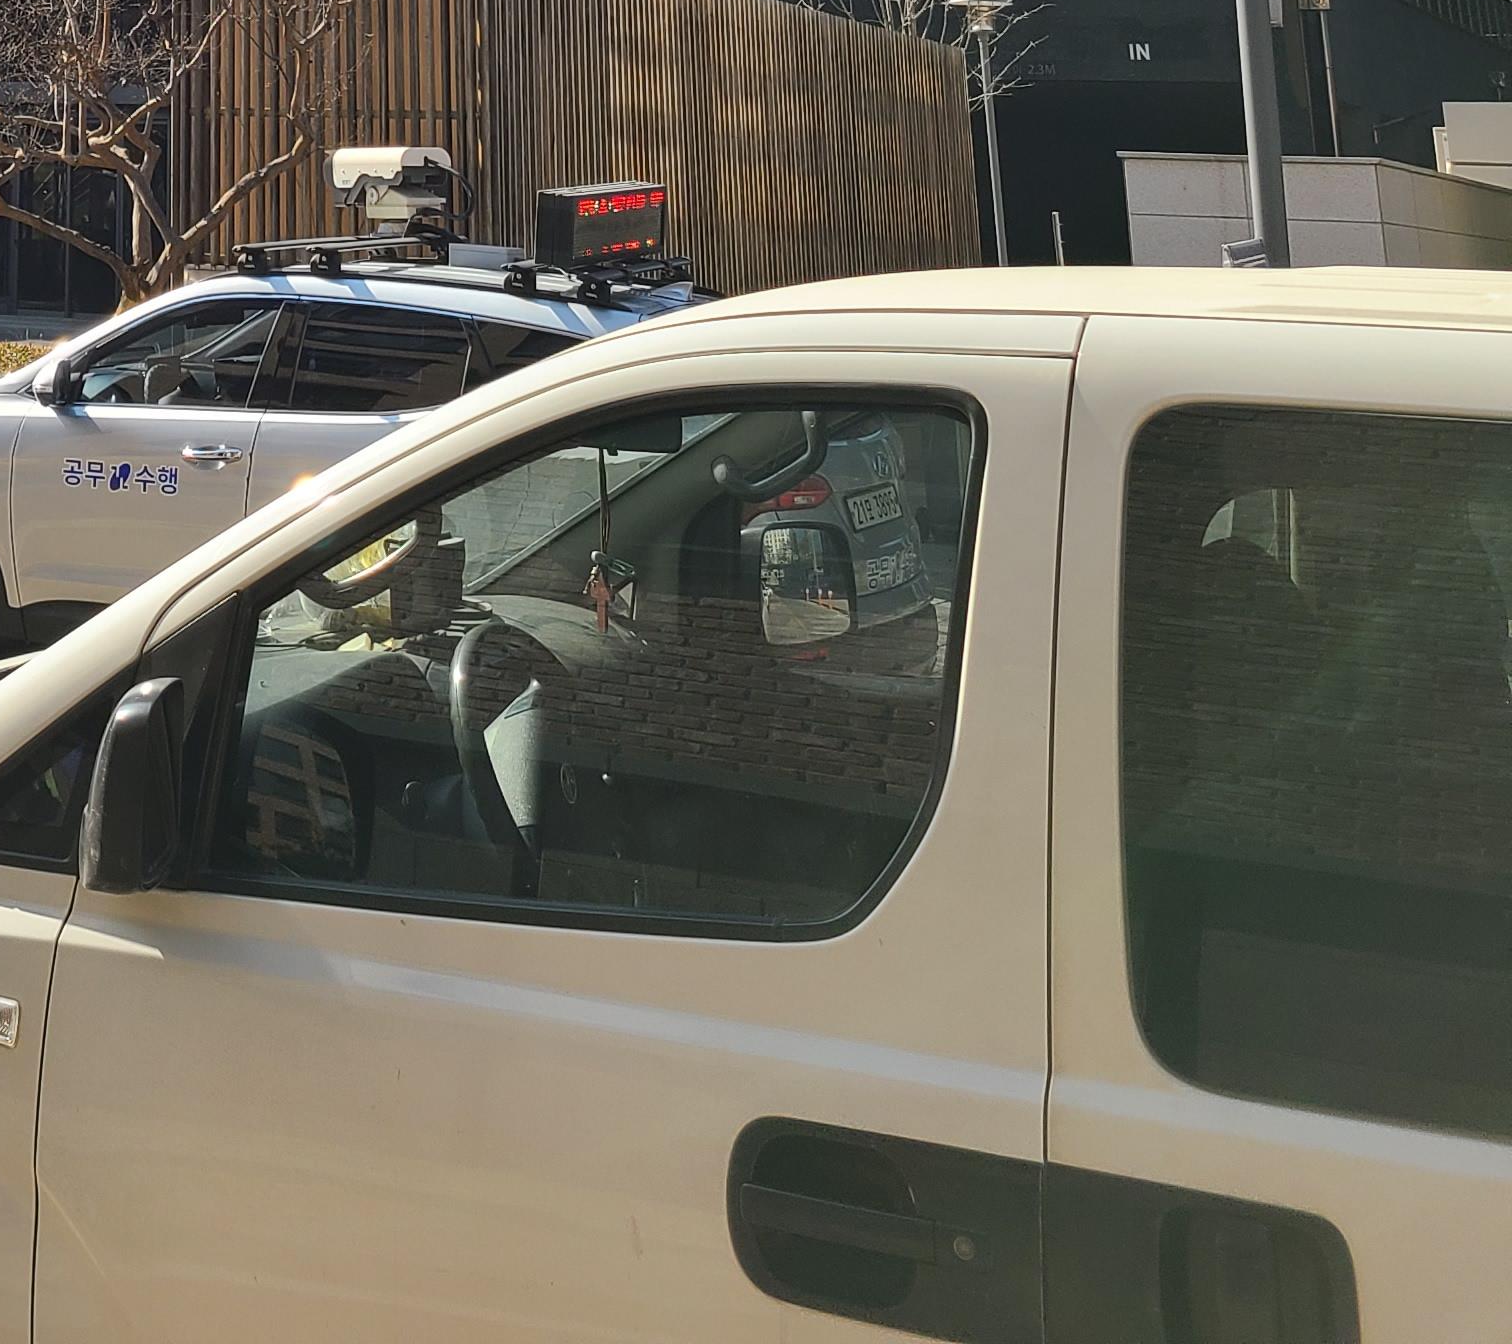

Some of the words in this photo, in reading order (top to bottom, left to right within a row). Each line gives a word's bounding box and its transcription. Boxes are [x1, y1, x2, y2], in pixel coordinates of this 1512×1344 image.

[1128, 43, 1152, 61] IN
[62, 458, 106, 488] 공무
[134, 465, 178, 495] 수행
